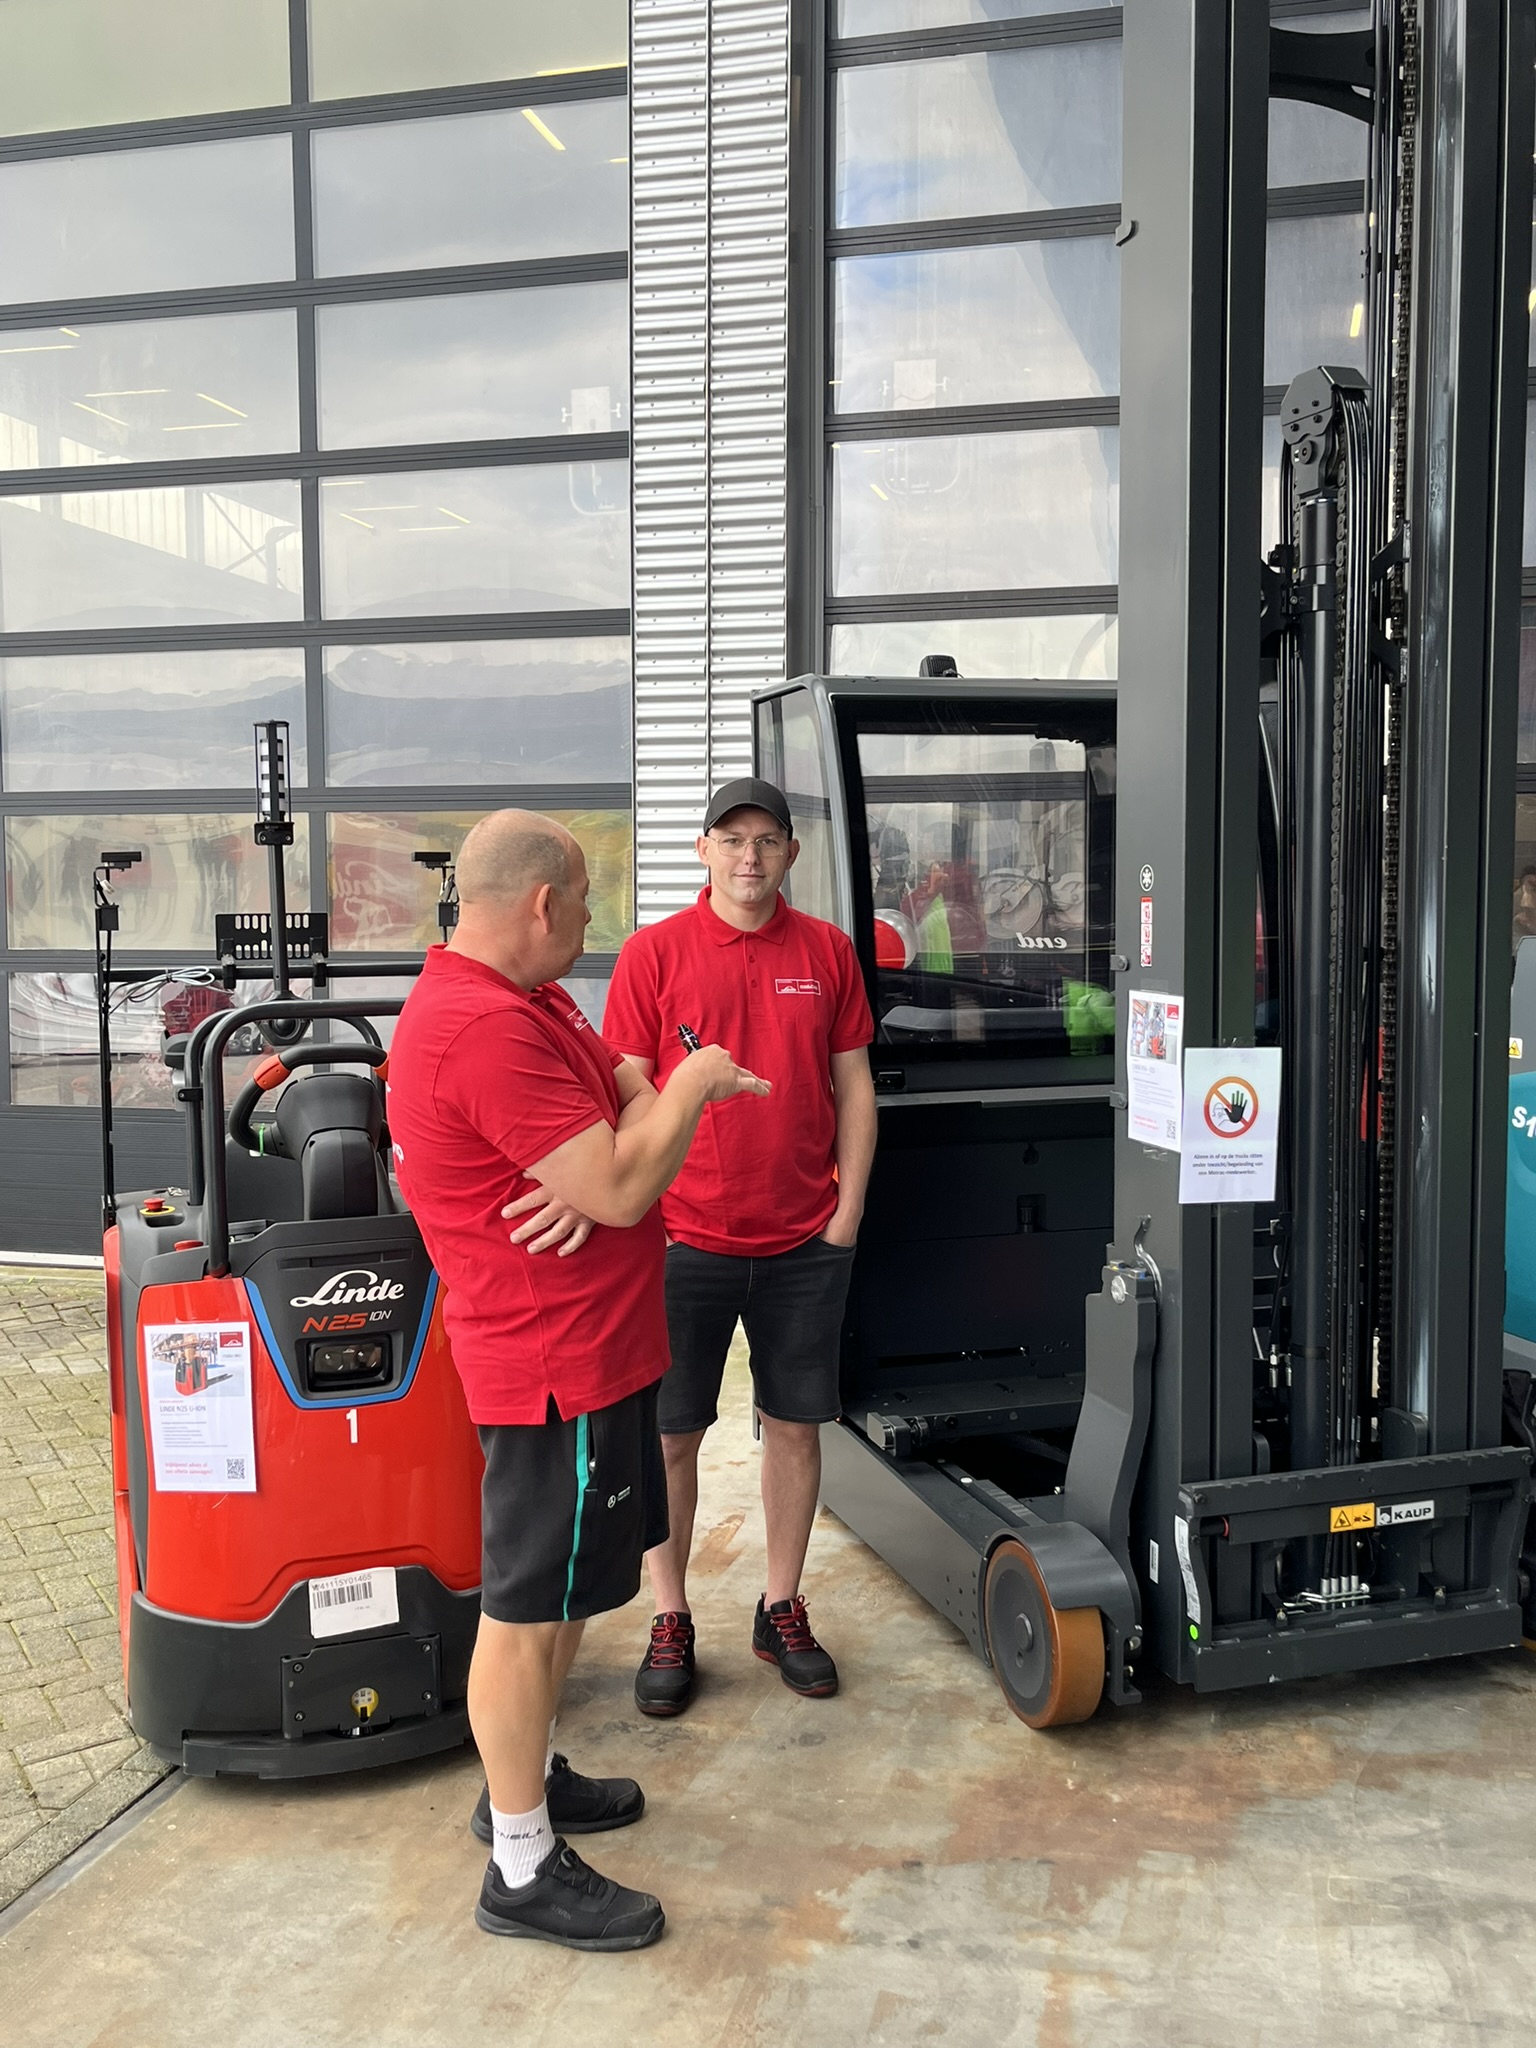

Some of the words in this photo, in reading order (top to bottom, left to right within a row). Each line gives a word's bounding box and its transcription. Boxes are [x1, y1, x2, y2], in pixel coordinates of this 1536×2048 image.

[290, 1269, 405, 1308] Linde
[302, 1312, 369, 1333] N25
[369, 1309, 392, 1322] ION
[346, 1408, 358, 1444] 1
[1394, 1507, 1432, 1520] KAUP
